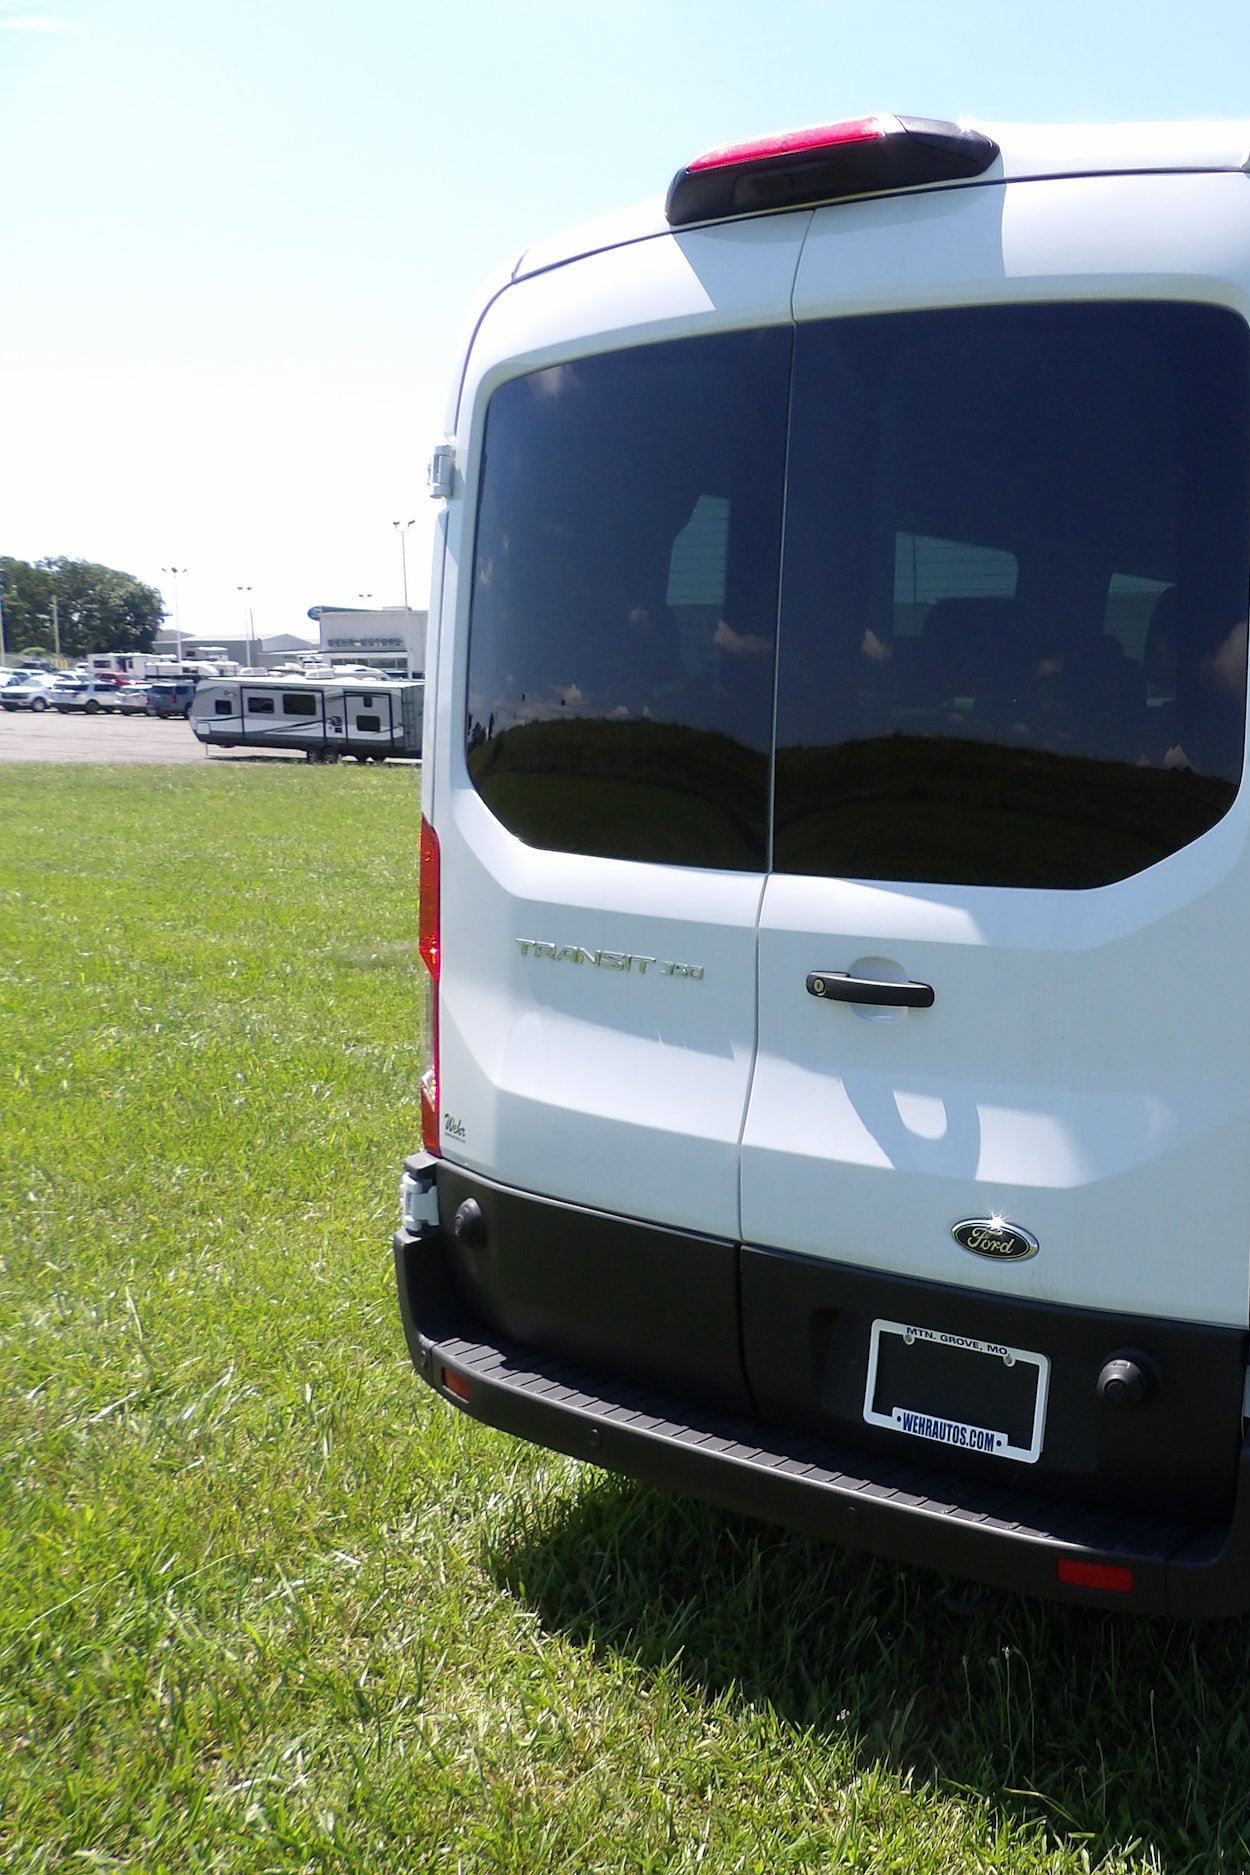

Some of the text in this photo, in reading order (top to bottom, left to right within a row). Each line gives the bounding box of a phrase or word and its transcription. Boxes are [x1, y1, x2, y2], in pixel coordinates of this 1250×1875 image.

[515, 937, 656, 974] TRANSIT
[967, 1227, 1015, 1253] Ford
[906, 1327, 936, 1340] MTN.
[940, 1334, 983, 1351] GROVE,
[903, 1412, 994, 1452] WEHRAUTOS.COM
